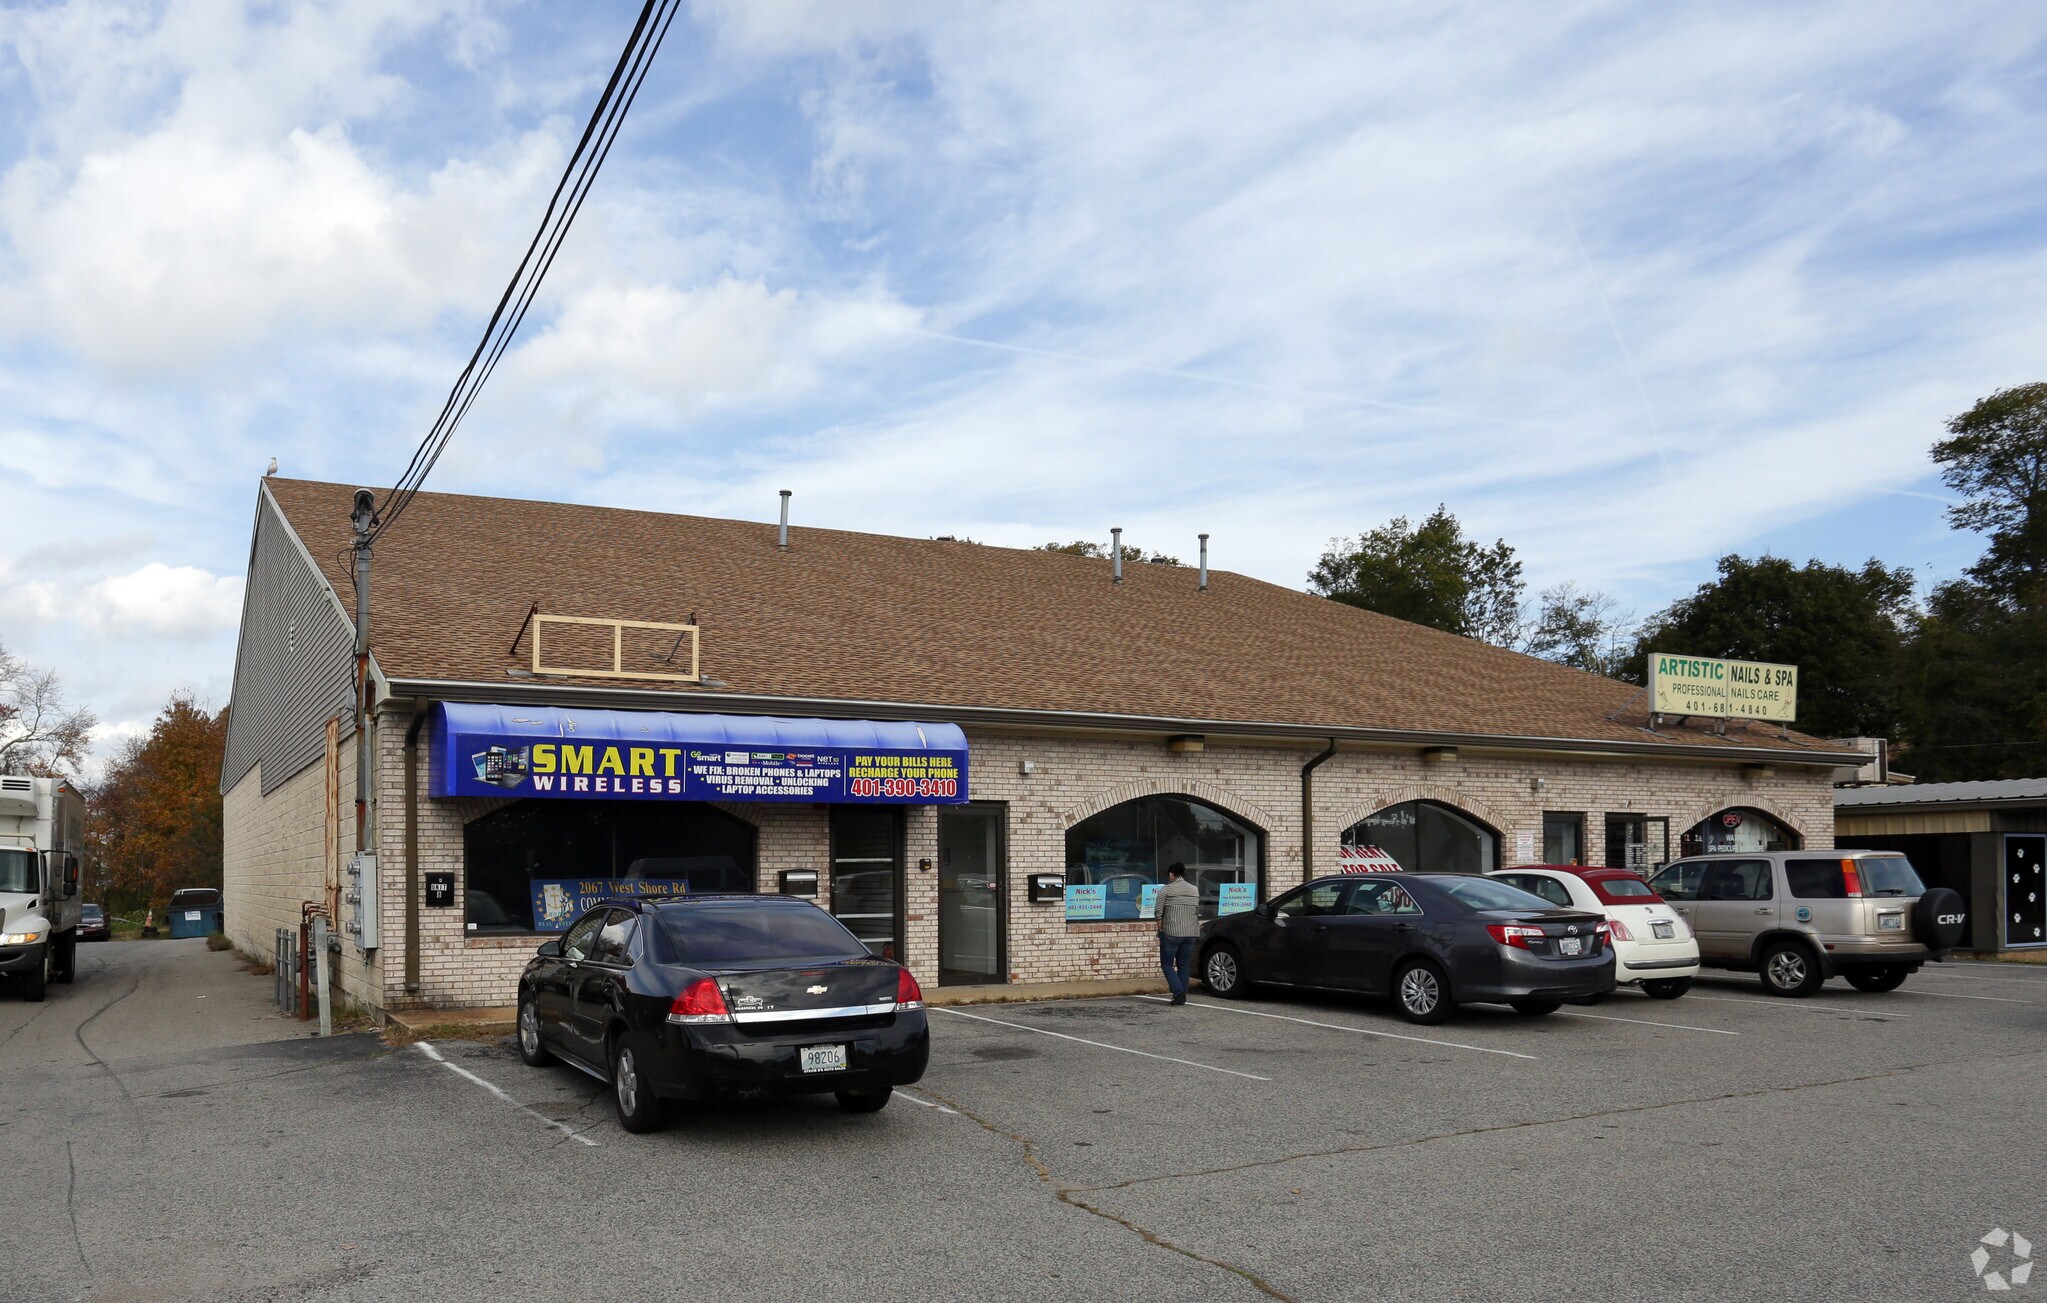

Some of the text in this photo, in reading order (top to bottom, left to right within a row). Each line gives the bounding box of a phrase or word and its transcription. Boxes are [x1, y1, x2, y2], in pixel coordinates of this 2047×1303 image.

[1658, 657, 1793, 687] ARTISTIC NAILS & SPA
[1672, 682, 1779, 701] PROFESSIONAL NAILS CARE
[1686, 700, 1767, 716] 401-681-4840
[532, 743, 682, 777] SMART
[855, 756, 953, 767] PAY YOUR BILLS HERE
[693, 765, 841, 778] WE FIX: BROKEN PHONES & LAPTOPS
[849, 767, 959, 779] RECHARGE YOUR PHONE
[532, 775, 681, 794] WIRELESS
[706, 775, 829, 787] VIRUS REMOVAL UNLOCKING
[851, 778, 957, 797] 401-390-3410
[722, 785, 814, 796] LAPTOP ACCESSORIES
[1723, 814, 1741, 824] OPEN
[1708, 845, 1717, 853] SPA
[579, 881, 686, 894] 2067 West Shore Rd
[1937, 913, 1965, 925] CR-V
[808, 1050, 840, 1064] 98206
